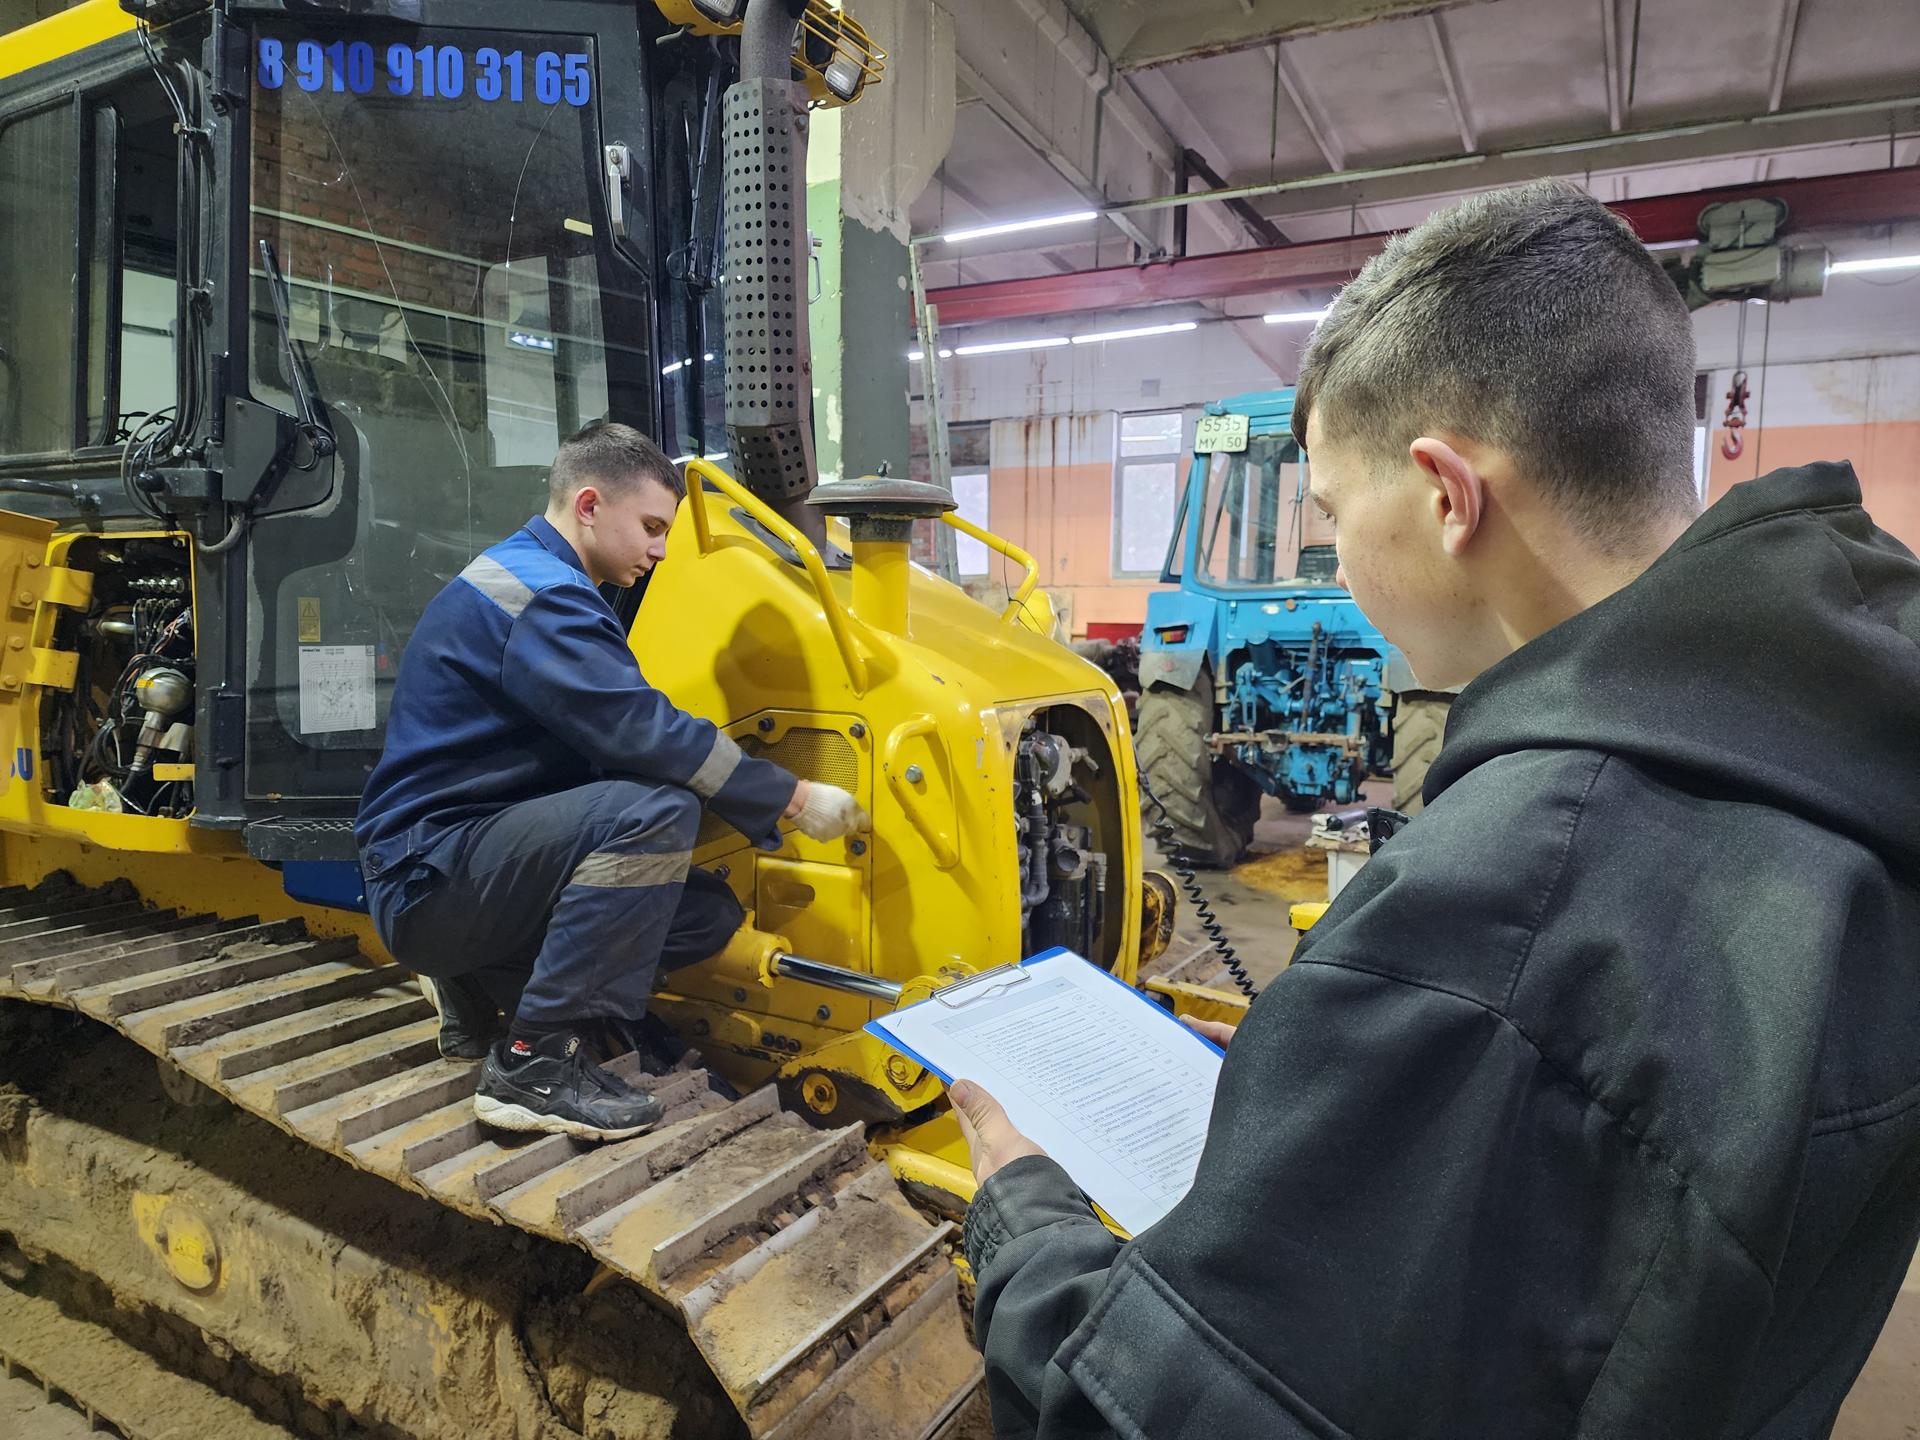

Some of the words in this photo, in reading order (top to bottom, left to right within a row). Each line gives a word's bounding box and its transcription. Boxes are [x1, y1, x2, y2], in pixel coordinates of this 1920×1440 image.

[257, 38, 284, 90] 8
[296, 39, 375, 94] 910
[386, 43, 464, 99] 910
[475, 47, 523, 103] 31
[535, 51, 590, 107] 65
[1226, 436, 1242, 448] 50
